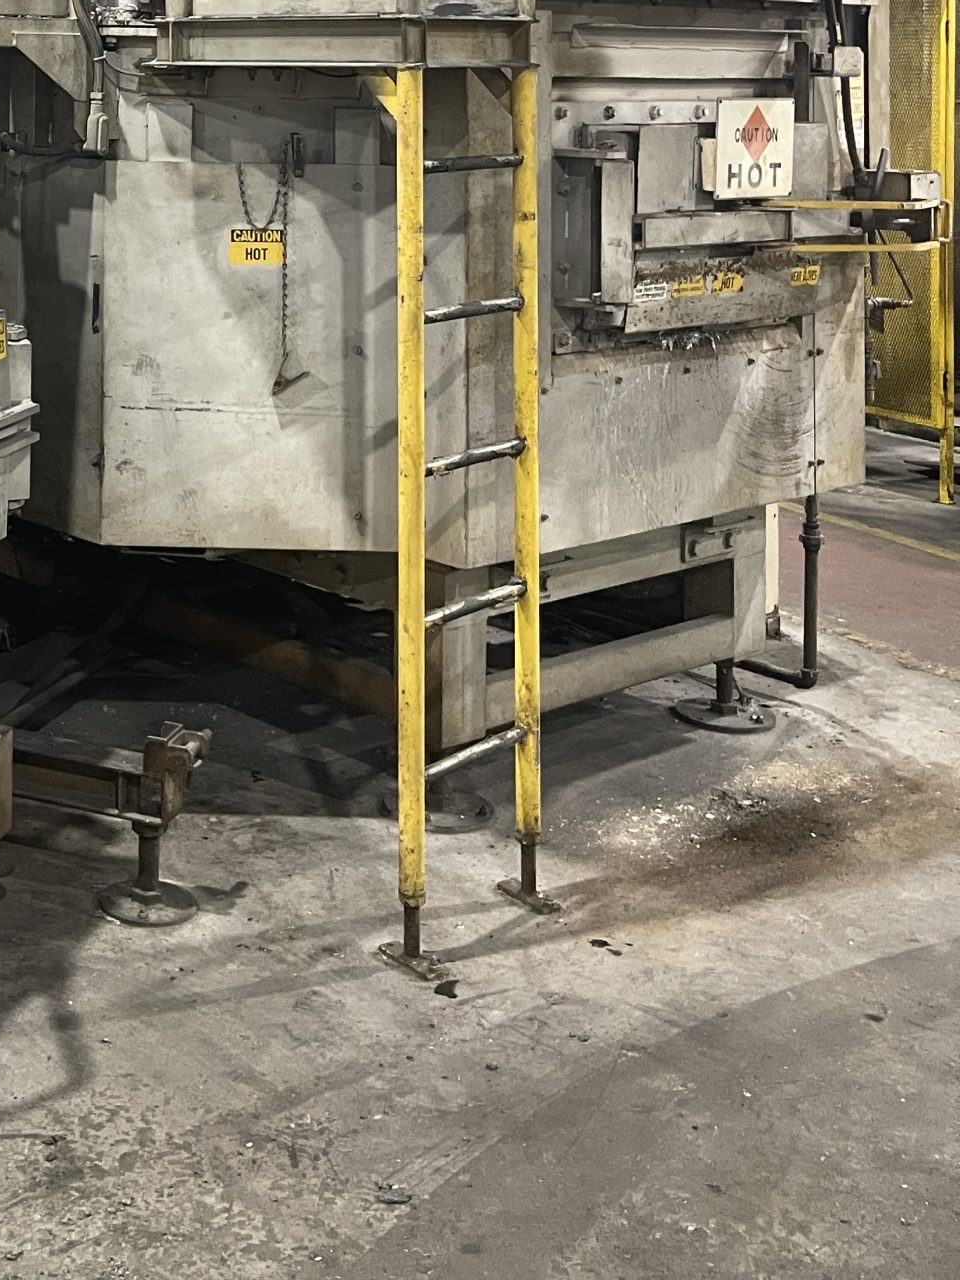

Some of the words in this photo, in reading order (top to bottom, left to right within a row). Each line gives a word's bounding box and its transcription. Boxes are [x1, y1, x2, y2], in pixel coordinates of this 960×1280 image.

[735, 128, 778, 143] CAUTION
[727, 162, 781, 189] HOT
[233, 230, 281, 242] CAUTION
[245, 248, 268, 260] HOT
[721, 276, 734, 290] HOT
